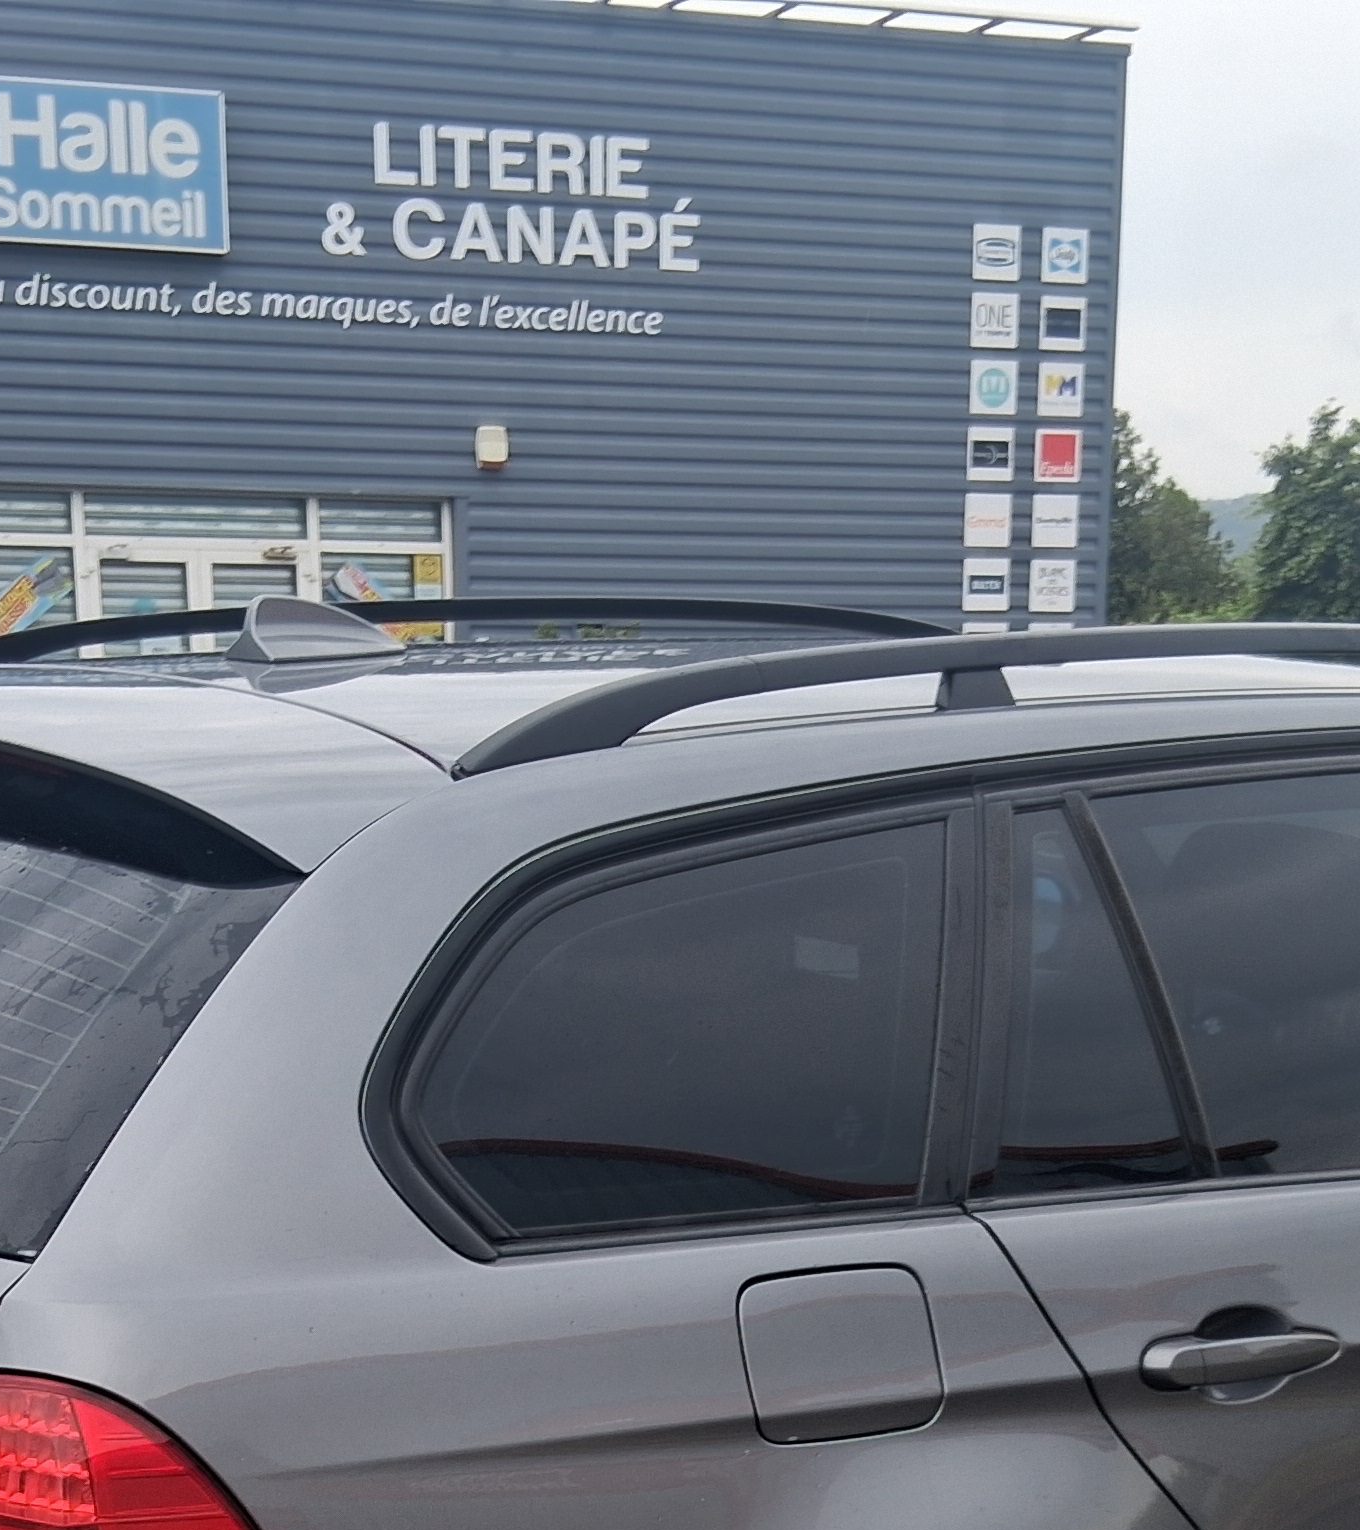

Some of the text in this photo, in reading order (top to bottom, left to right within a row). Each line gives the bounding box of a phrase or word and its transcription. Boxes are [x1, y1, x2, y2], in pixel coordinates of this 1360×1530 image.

[373, 121, 650, 199] LITERIE
[321, 198, 702, 272] & CANAPÉ
[15, 273, 184, 318] discount,
[192, 281, 252, 316] des
[261, 293, 419, 329] marques,
[430, 293, 469, 327] de
[479, 295, 664, 336] l'excellence
[976, 304, 1012, 328] ONE
